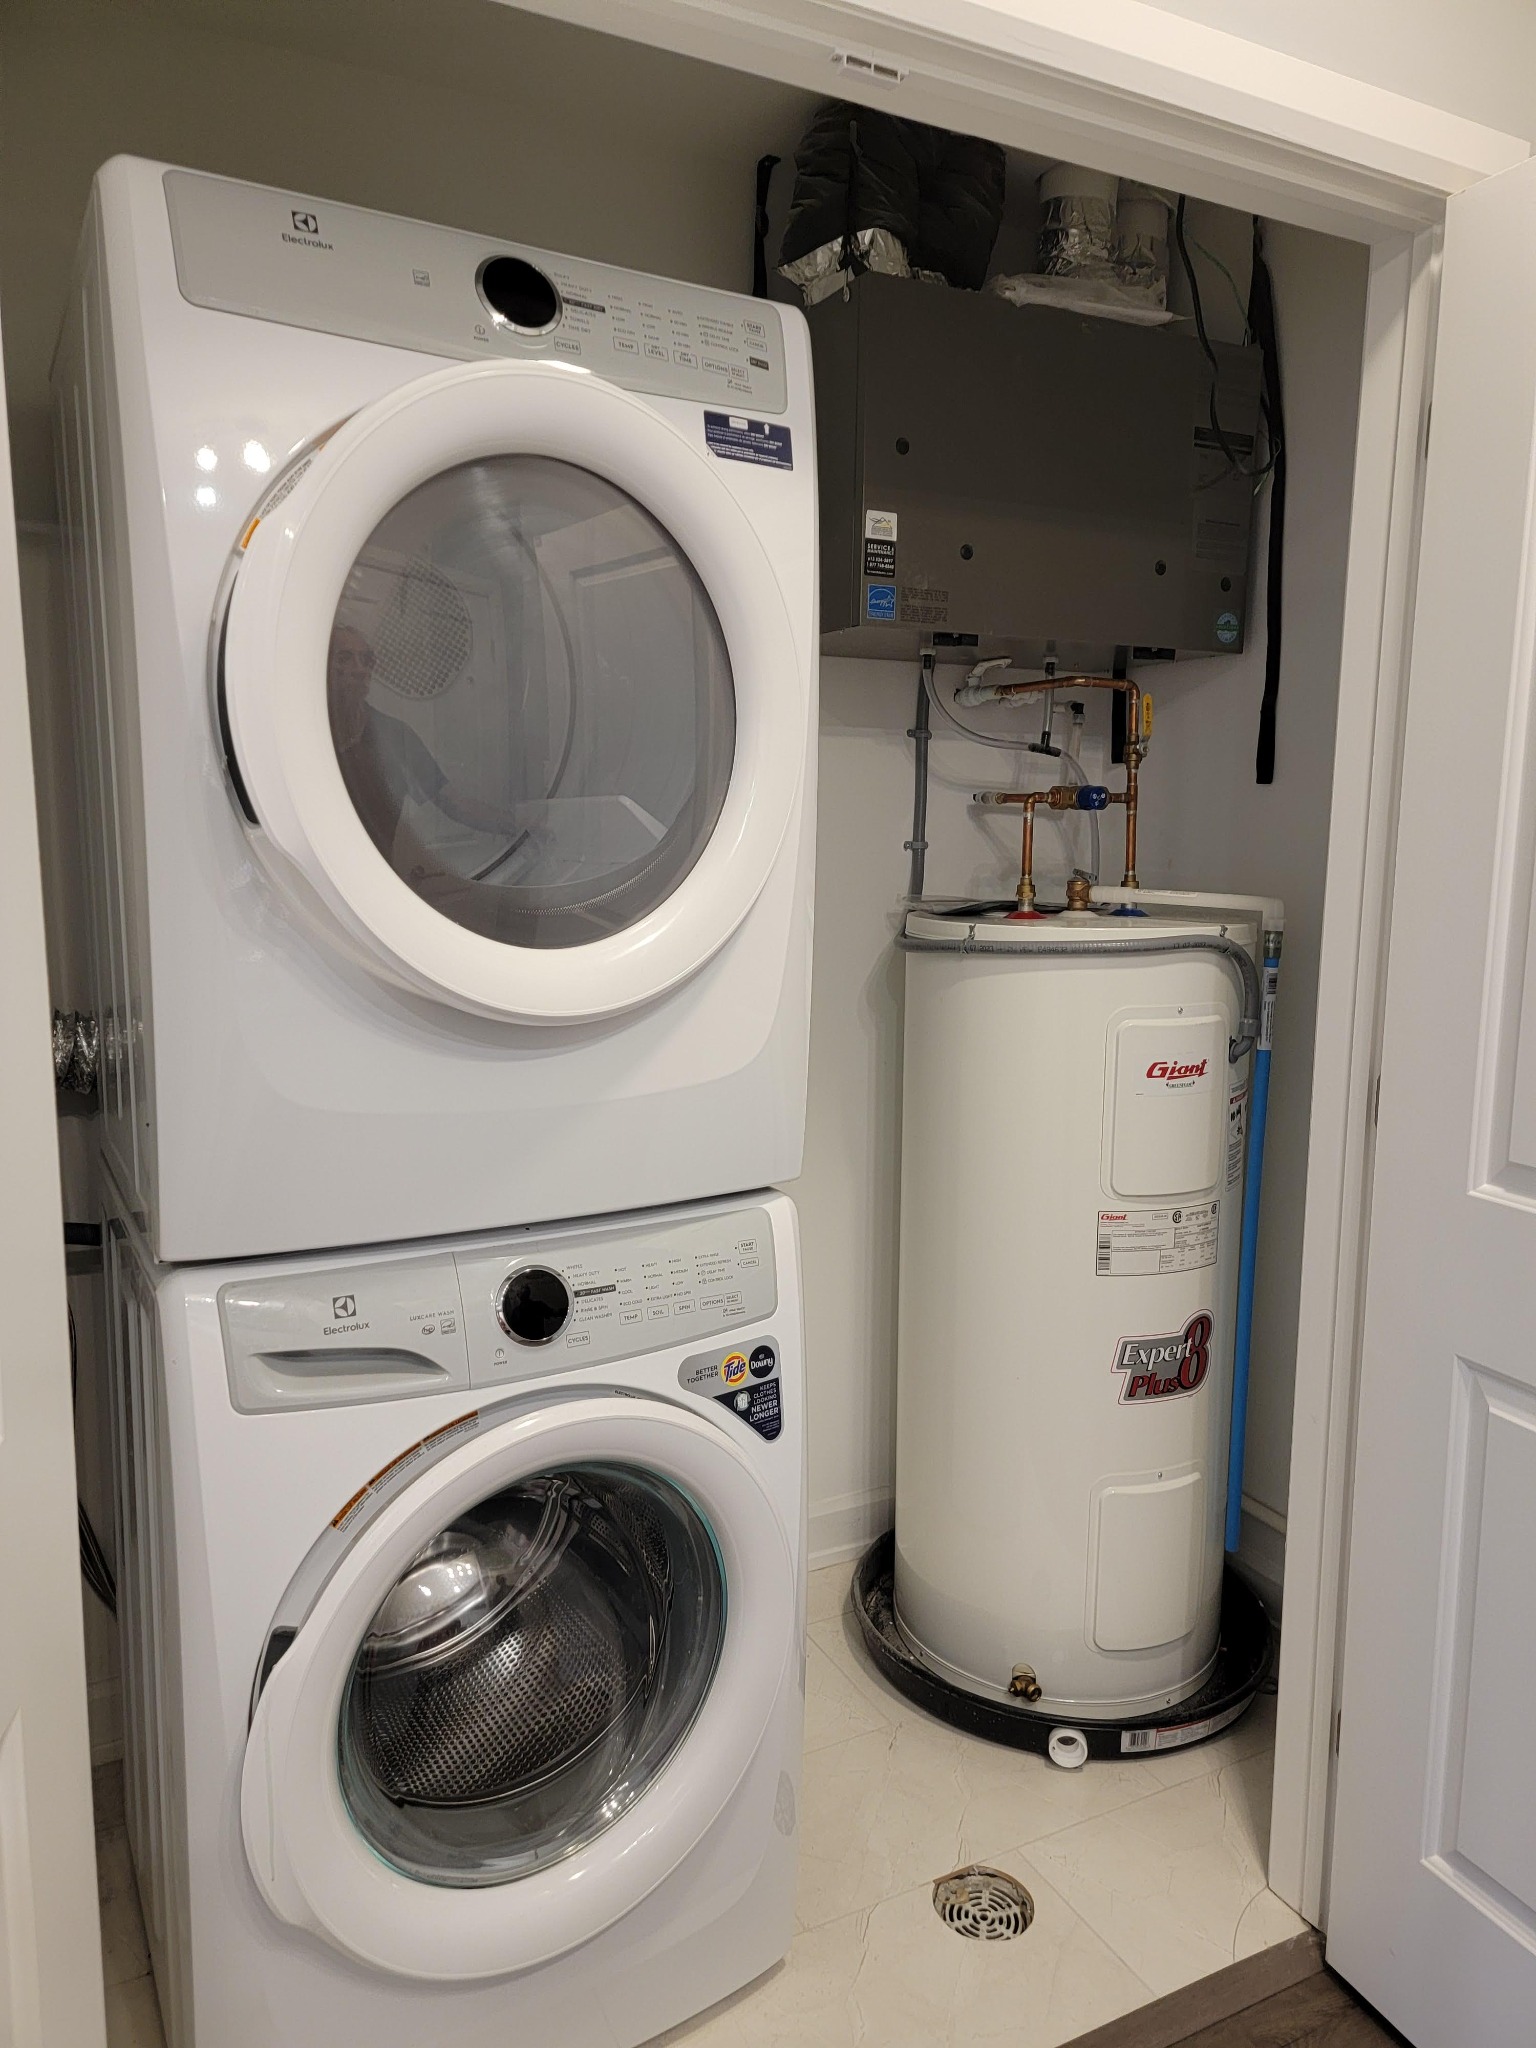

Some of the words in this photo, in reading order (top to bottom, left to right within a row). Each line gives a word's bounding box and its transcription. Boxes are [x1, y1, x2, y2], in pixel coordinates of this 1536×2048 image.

[281, 232, 335, 251] Electrolux
[555, 341, 580, 351] CYCLES
[618, 341, 634, 349] TEMP
[647, 348, 665, 357] LEVEL
[704, 360, 728, 373] OPTIONS
[867, 542, 891, 551] SERVICE
[1146, 1059, 1208, 1080] Giant
[1100, 1213, 1128, 1221] Giant
[580, 1296, 604, 1304] DELICATES
[701, 1298, 724, 1307] OPTIONS
[409, 1312, 436, 1322] LUXCARE
[594, 1312, 613, 1320] WASHER
[623, 1313, 639, 1321] TEMP
[322, 1321, 370, 1336] Electrolux
[567, 1335, 589, 1344] CYCLES
[1121, 1337, 1193, 1371] Expert
[1178, 1315, 1211, 1390] 8
[750, 1357, 774, 1370] Downy
[695, 1364, 718, 1376] BETTER
[723, 1359, 746, 1383] Tide
[687, 1371, 719, 1384] TOGETHER
[759, 1381, 777, 1391] KEEPS
[1128, 1372, 1181, 1397] Plus
[753, 1387, 777, 1399] CLOTHES
[753, 1393, 777, 1405] LOOKING
[751, 1400, 778, 1414] NEWER
[749, 1407, 779, 1422] LONGER
